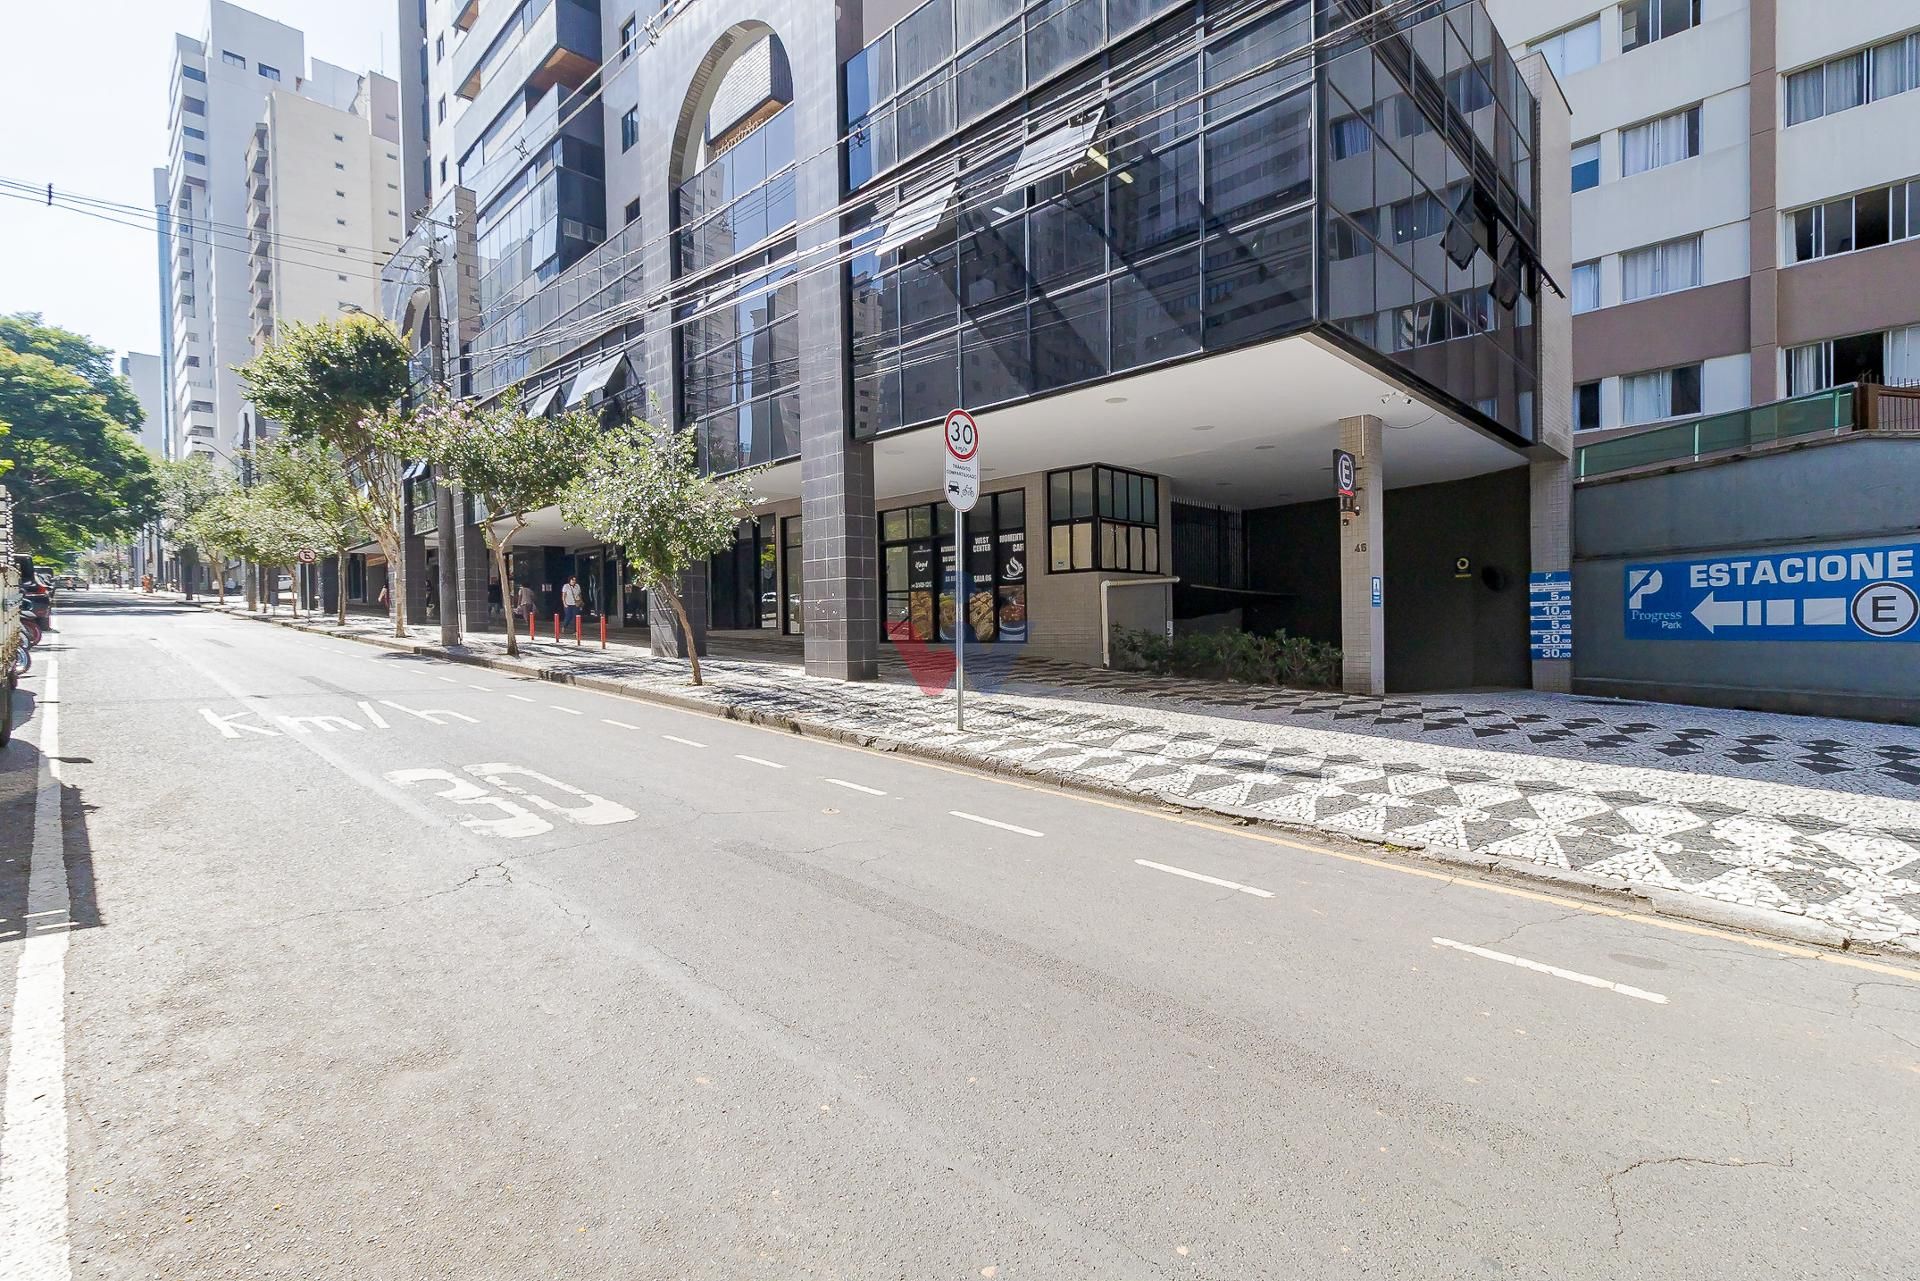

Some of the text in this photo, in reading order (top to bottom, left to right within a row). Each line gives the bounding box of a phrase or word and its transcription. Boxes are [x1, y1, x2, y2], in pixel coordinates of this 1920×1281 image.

[951, 421, 973, 444] 30
[1342, 460, 1350, 484] E
[1690, 549, 1914, 588] ESTACIONE
[1631, 610, 1683, 622] Progress
[1872, 596, 1897, 623] E
[1661, 620, 1683, 629] Park
[384, 763, 640, 838] 30
